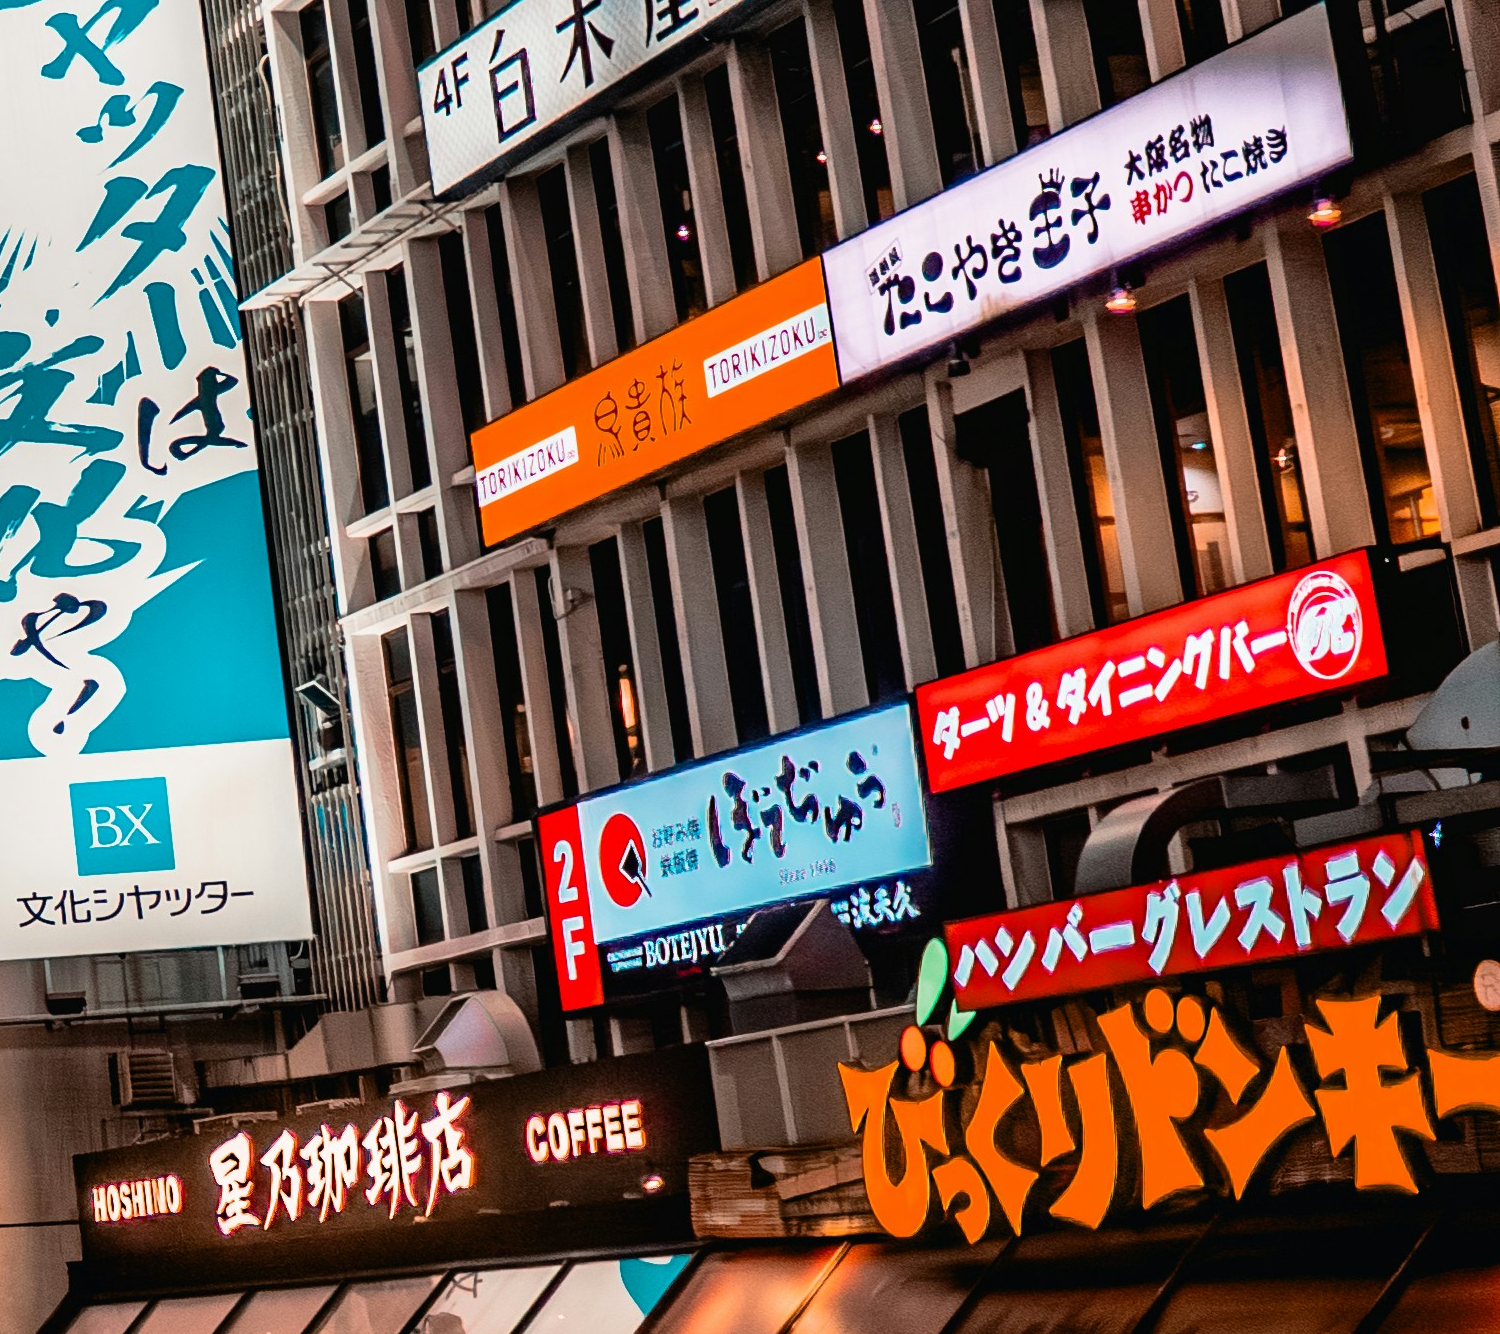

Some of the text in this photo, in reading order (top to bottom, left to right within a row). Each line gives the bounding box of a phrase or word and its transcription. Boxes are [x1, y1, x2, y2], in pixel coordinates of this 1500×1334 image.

[431, 52, 471, 118] 4F
[1129, 170, 1195, 226] 串かつ
[707, 310, 819, 389] TORIKIZOKU
[85, 799, 162, 854] BX
[552, 839, 587, 982] 2F
[952, 846, 1426, 993] ハンバーグレストラン
[526, 1098, 645, 1165] COFFEE
[836, 987, 1500, 1246] びっくりドンキー
[91, 1175, 182, 1224] HOSHINO
[207, 1090, 476, 1237] 星乃珈琲店
